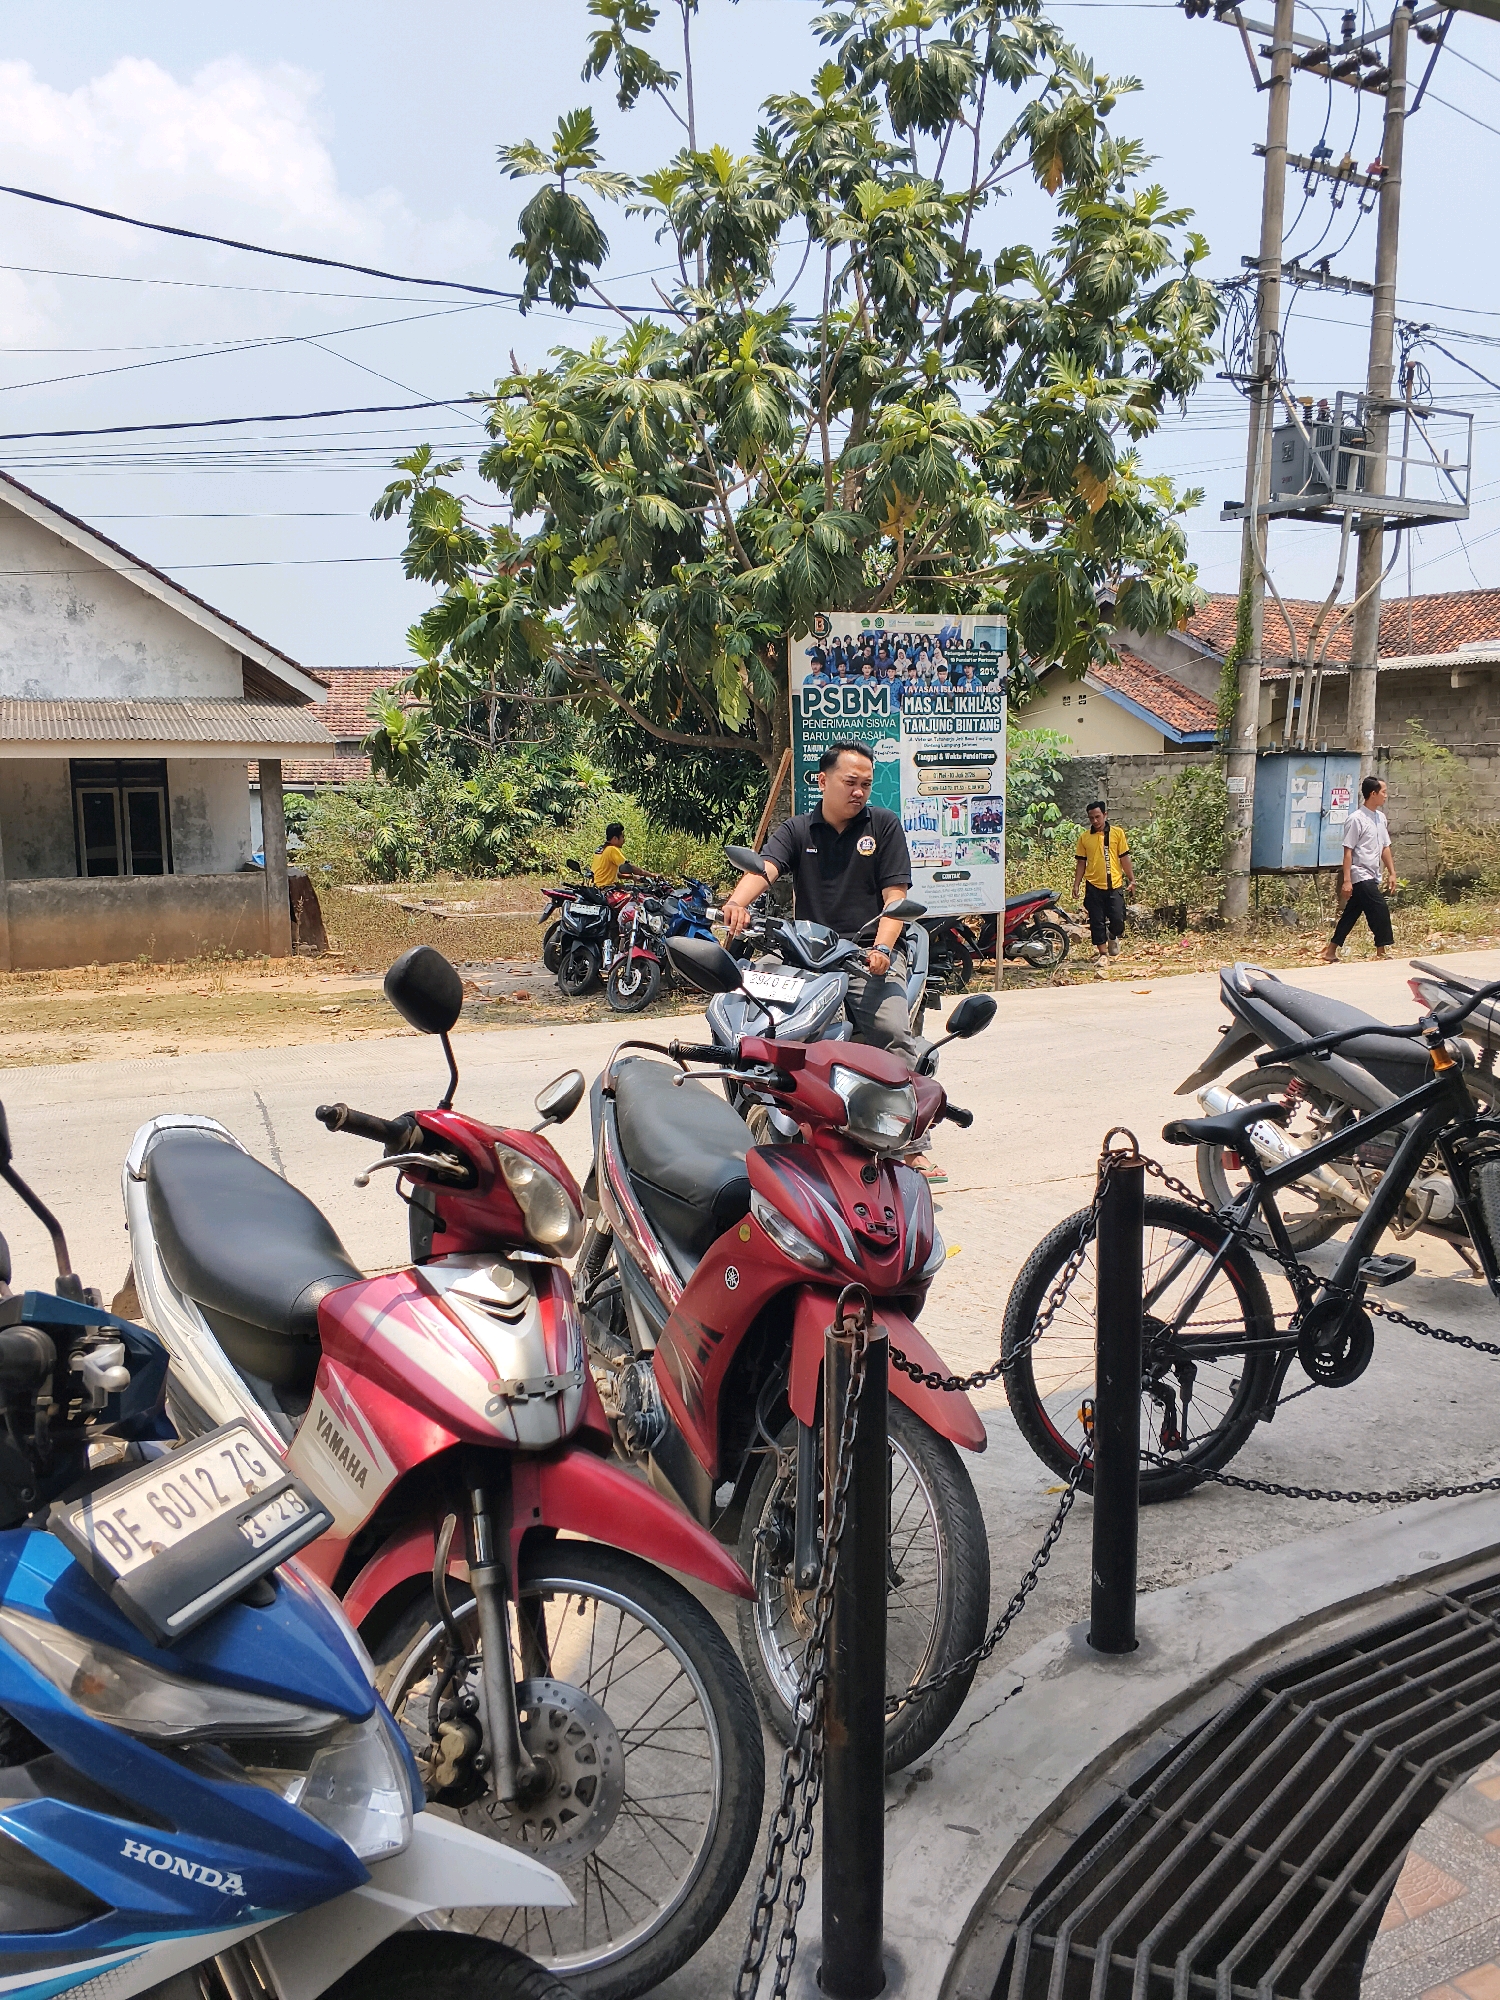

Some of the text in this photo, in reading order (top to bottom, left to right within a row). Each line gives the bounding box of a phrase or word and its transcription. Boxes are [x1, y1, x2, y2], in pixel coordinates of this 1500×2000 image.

[979, 667, 997, 676] 20%
[904, 685, 1002, 693] YAYASAN ISLAM AL IKHLAS
[802, 686, 889, 716] PSBM
[904, 695, 1001, 713] MAS AL IKHLAS
[802, 718, 897, 729] PENERIMAAN SISWA
[904, 718, 1001, 733] TANJUNG BINTANG
[802, 731, 886, 741] BARU MADRASAH
[803, 744, 824, 753] TAHUN
[916, 753, 939, 762] Tanggal
[944, 752, 962, 760] Waktu
[315, 1409, 371, 1490] YAMAHA
[94, 1507, 153, 1562] BE
[146, 1466, 231, 1530] 6012
[120, 1837, 247, 1897] HONDA
